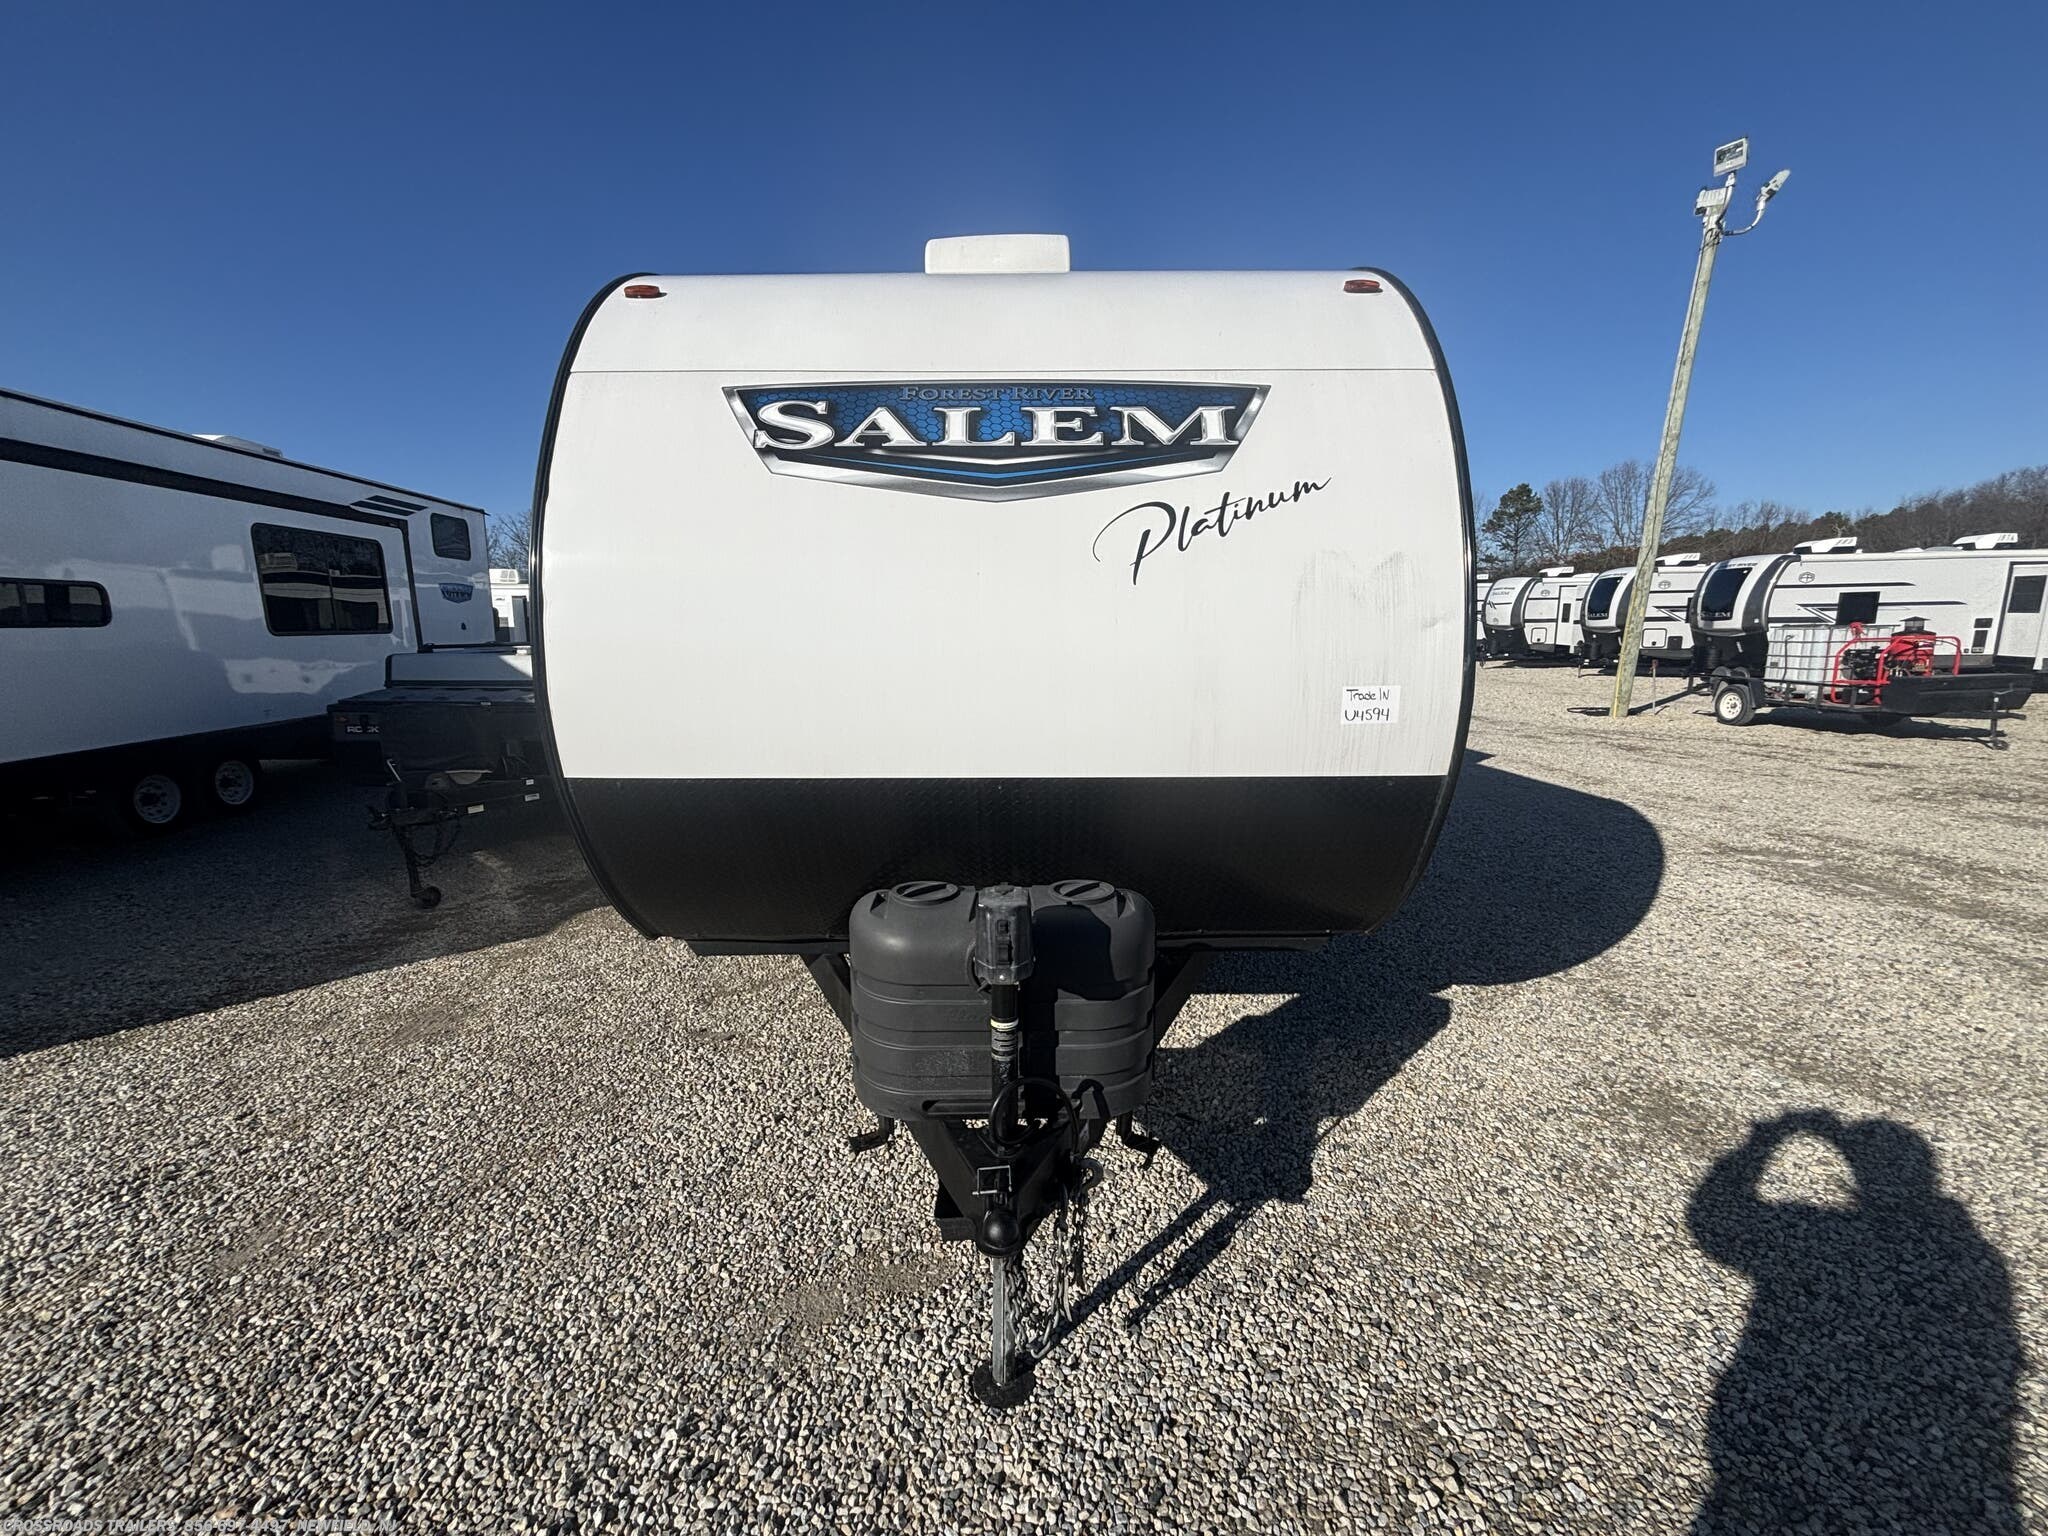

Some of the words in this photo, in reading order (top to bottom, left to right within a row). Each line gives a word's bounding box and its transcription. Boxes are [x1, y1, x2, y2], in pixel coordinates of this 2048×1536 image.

[900, 386, 1004, 400] FOREST
[1011, 386, 1095, 400] RIVER
[753, 400, 1240, 449] SALEM
[1092, 476, 1333, 586] Platinum
[1346, 688, 1377, 702] Trade
[1344, 707, 1390, 721] U4594
